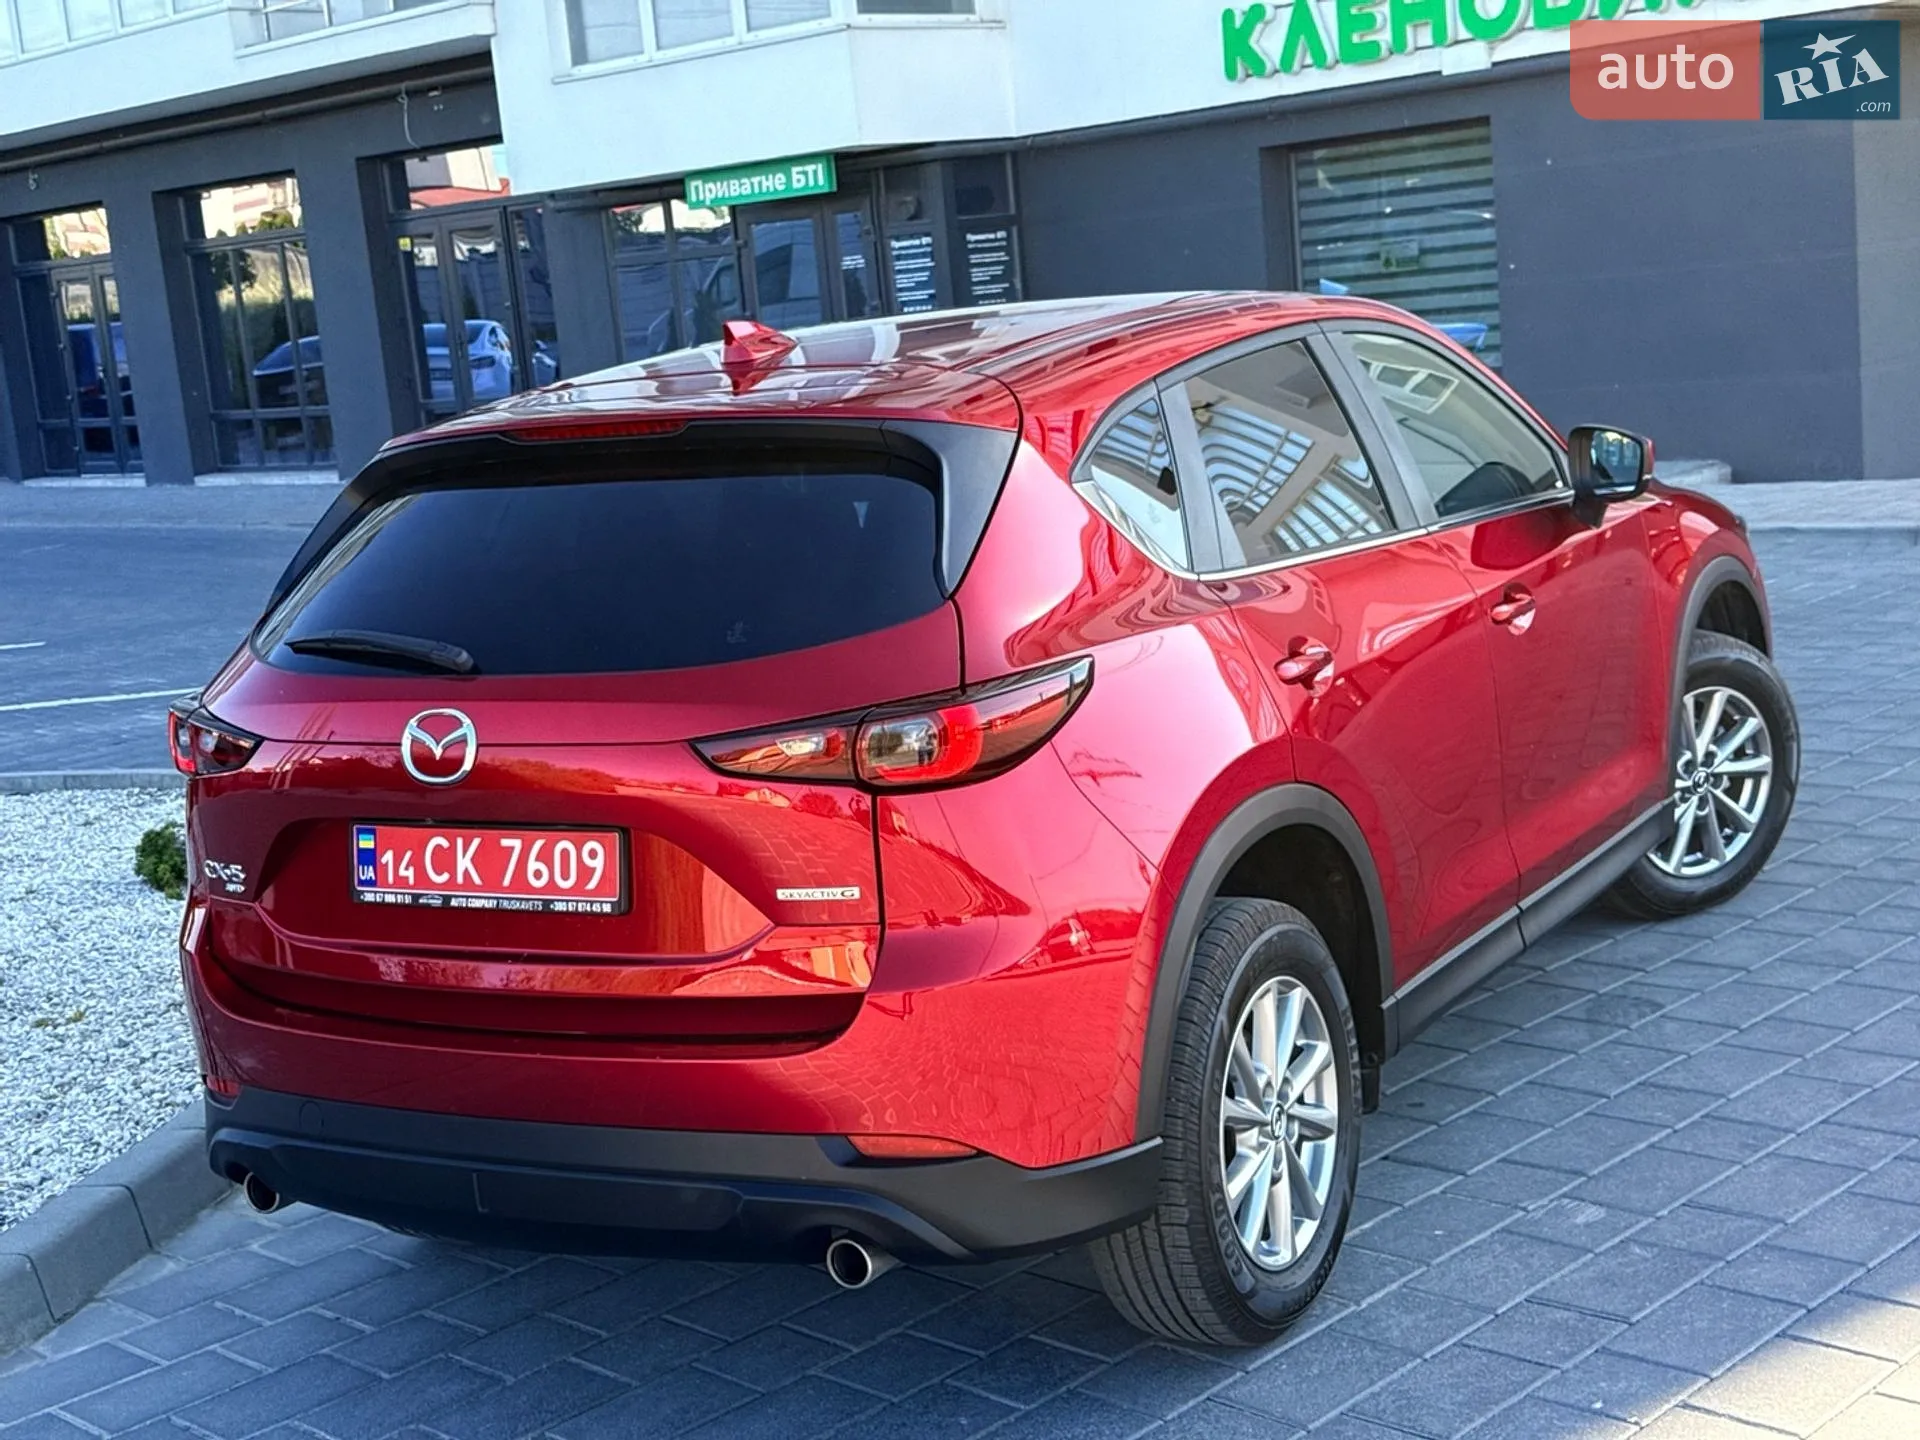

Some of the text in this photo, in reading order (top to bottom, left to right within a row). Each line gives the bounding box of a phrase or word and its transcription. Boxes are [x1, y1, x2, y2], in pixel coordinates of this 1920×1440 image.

[689, 163, 825, 205] Приватне БТІ
[358, 865, 376, 881] UA
[380, 835, 605, 889] 14 CK 7609
